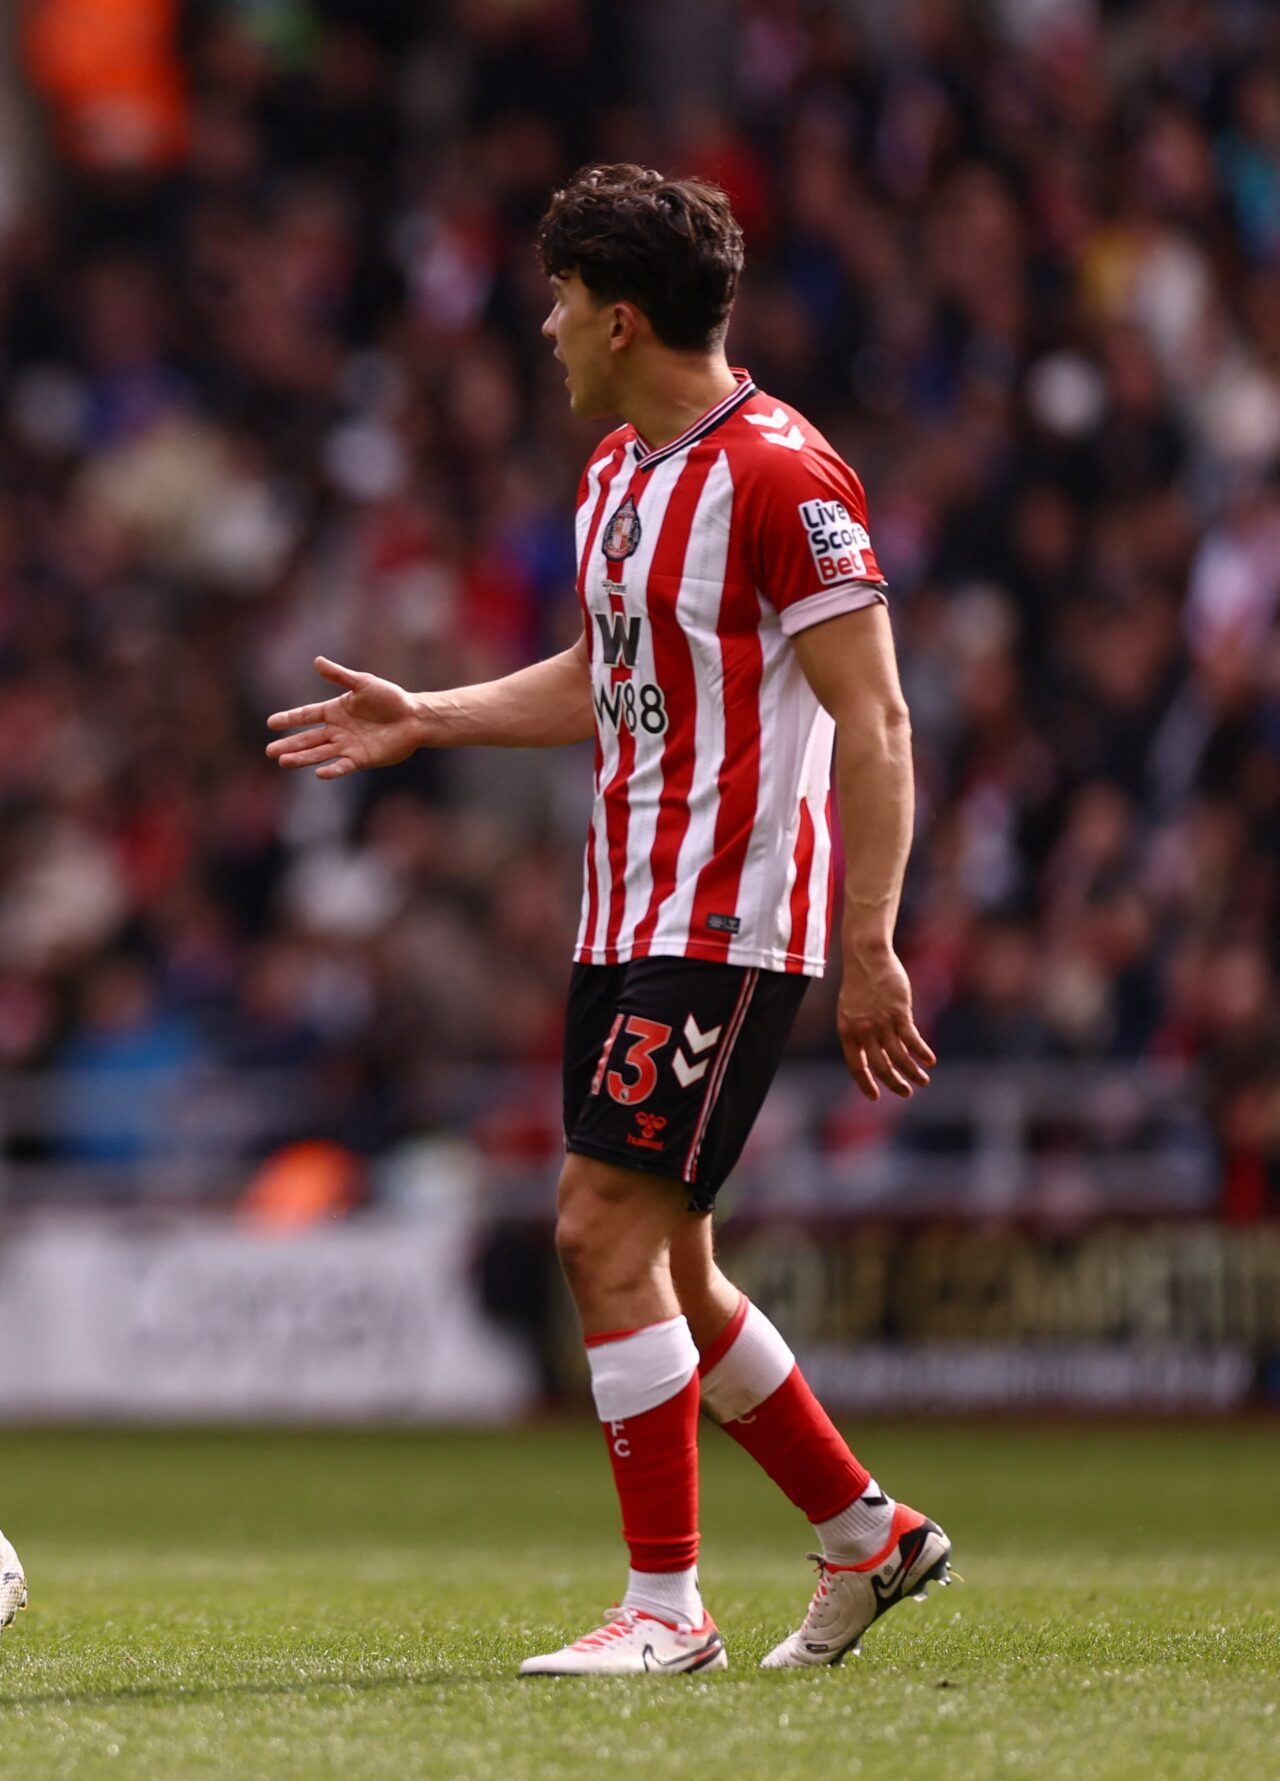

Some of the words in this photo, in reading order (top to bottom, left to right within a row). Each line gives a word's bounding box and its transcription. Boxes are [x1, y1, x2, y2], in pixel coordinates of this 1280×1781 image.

[802, 502, 847, 528] Live
[811, 528, 867, 555] Score
[818, 550, 861, 580] Bet
[594, 613, 641, 667] W
[592, 682, 666, 734] W88
[611, 1420, 631, 1457] FC
